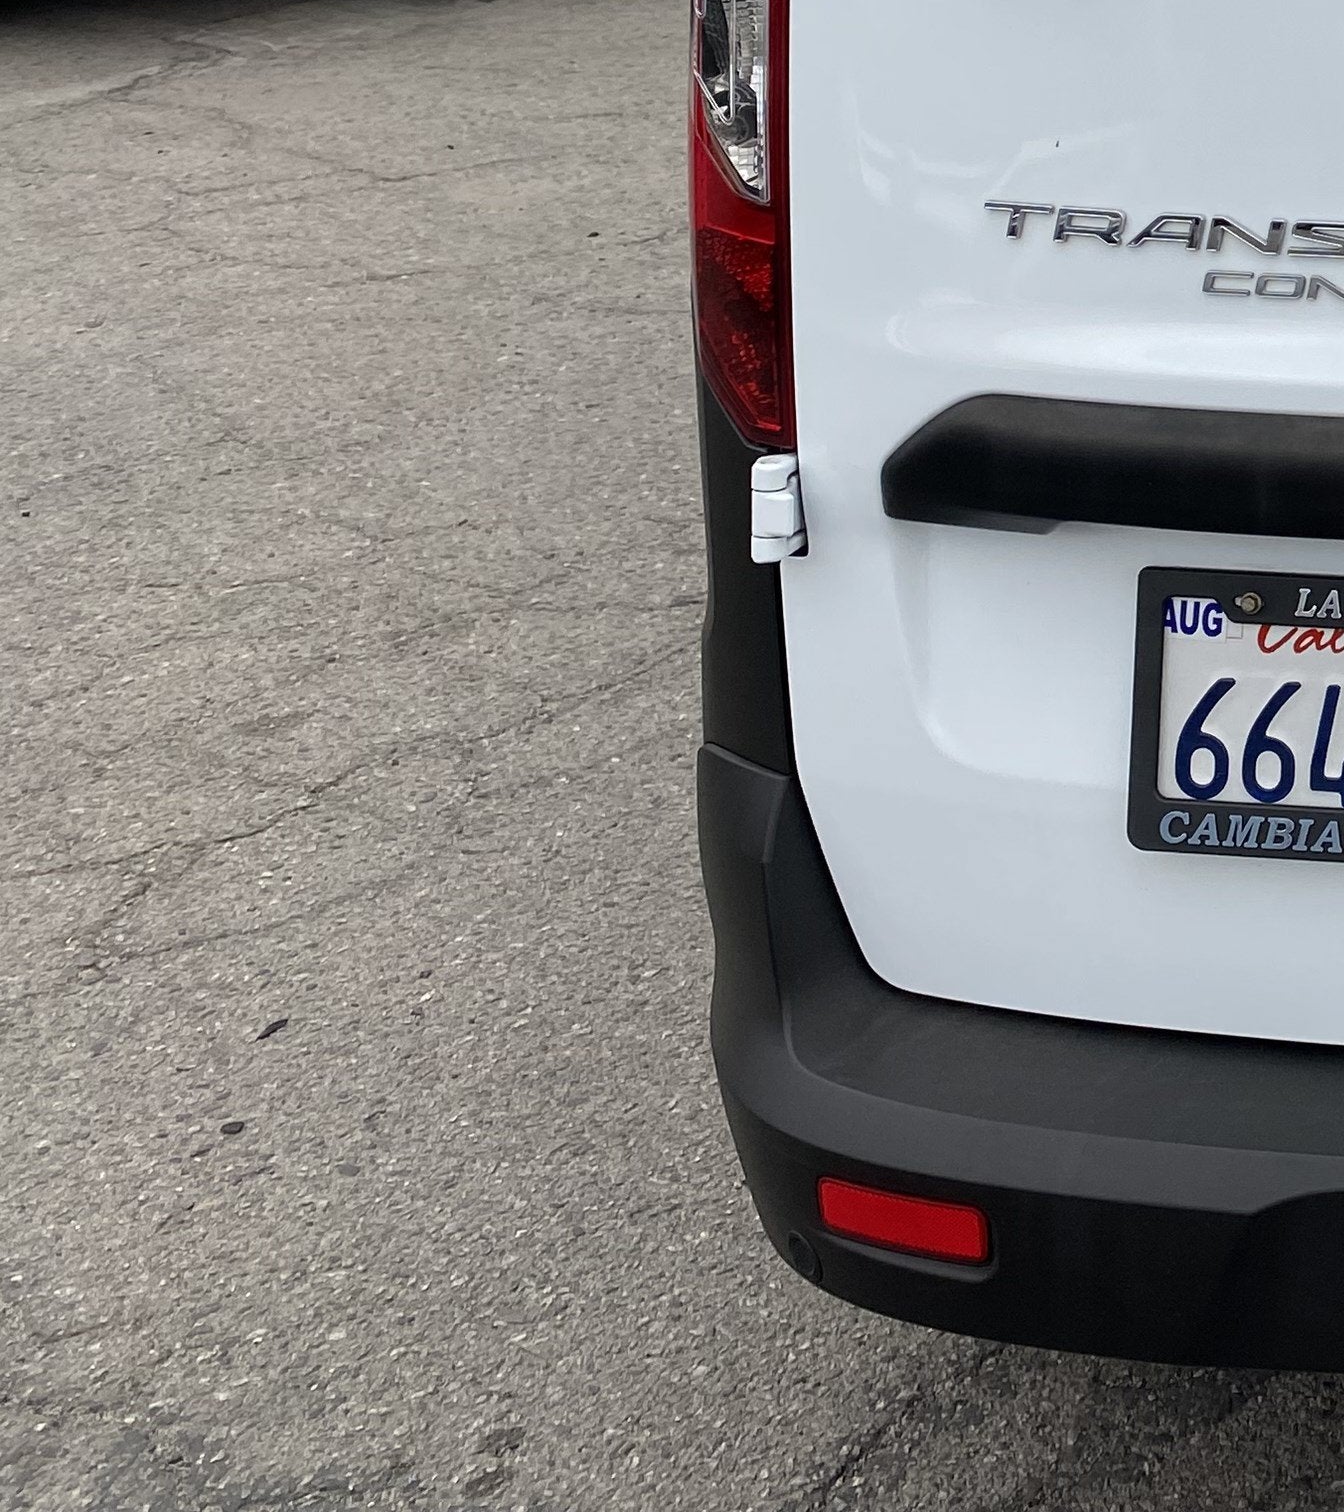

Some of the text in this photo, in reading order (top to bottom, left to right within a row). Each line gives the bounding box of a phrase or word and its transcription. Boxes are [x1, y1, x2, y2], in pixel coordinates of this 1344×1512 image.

[1164, 597, 1223, 637] AUG
[1294, 588, 1342, 619] LA
[1159, 810, 1344, 854] CAMBIA
